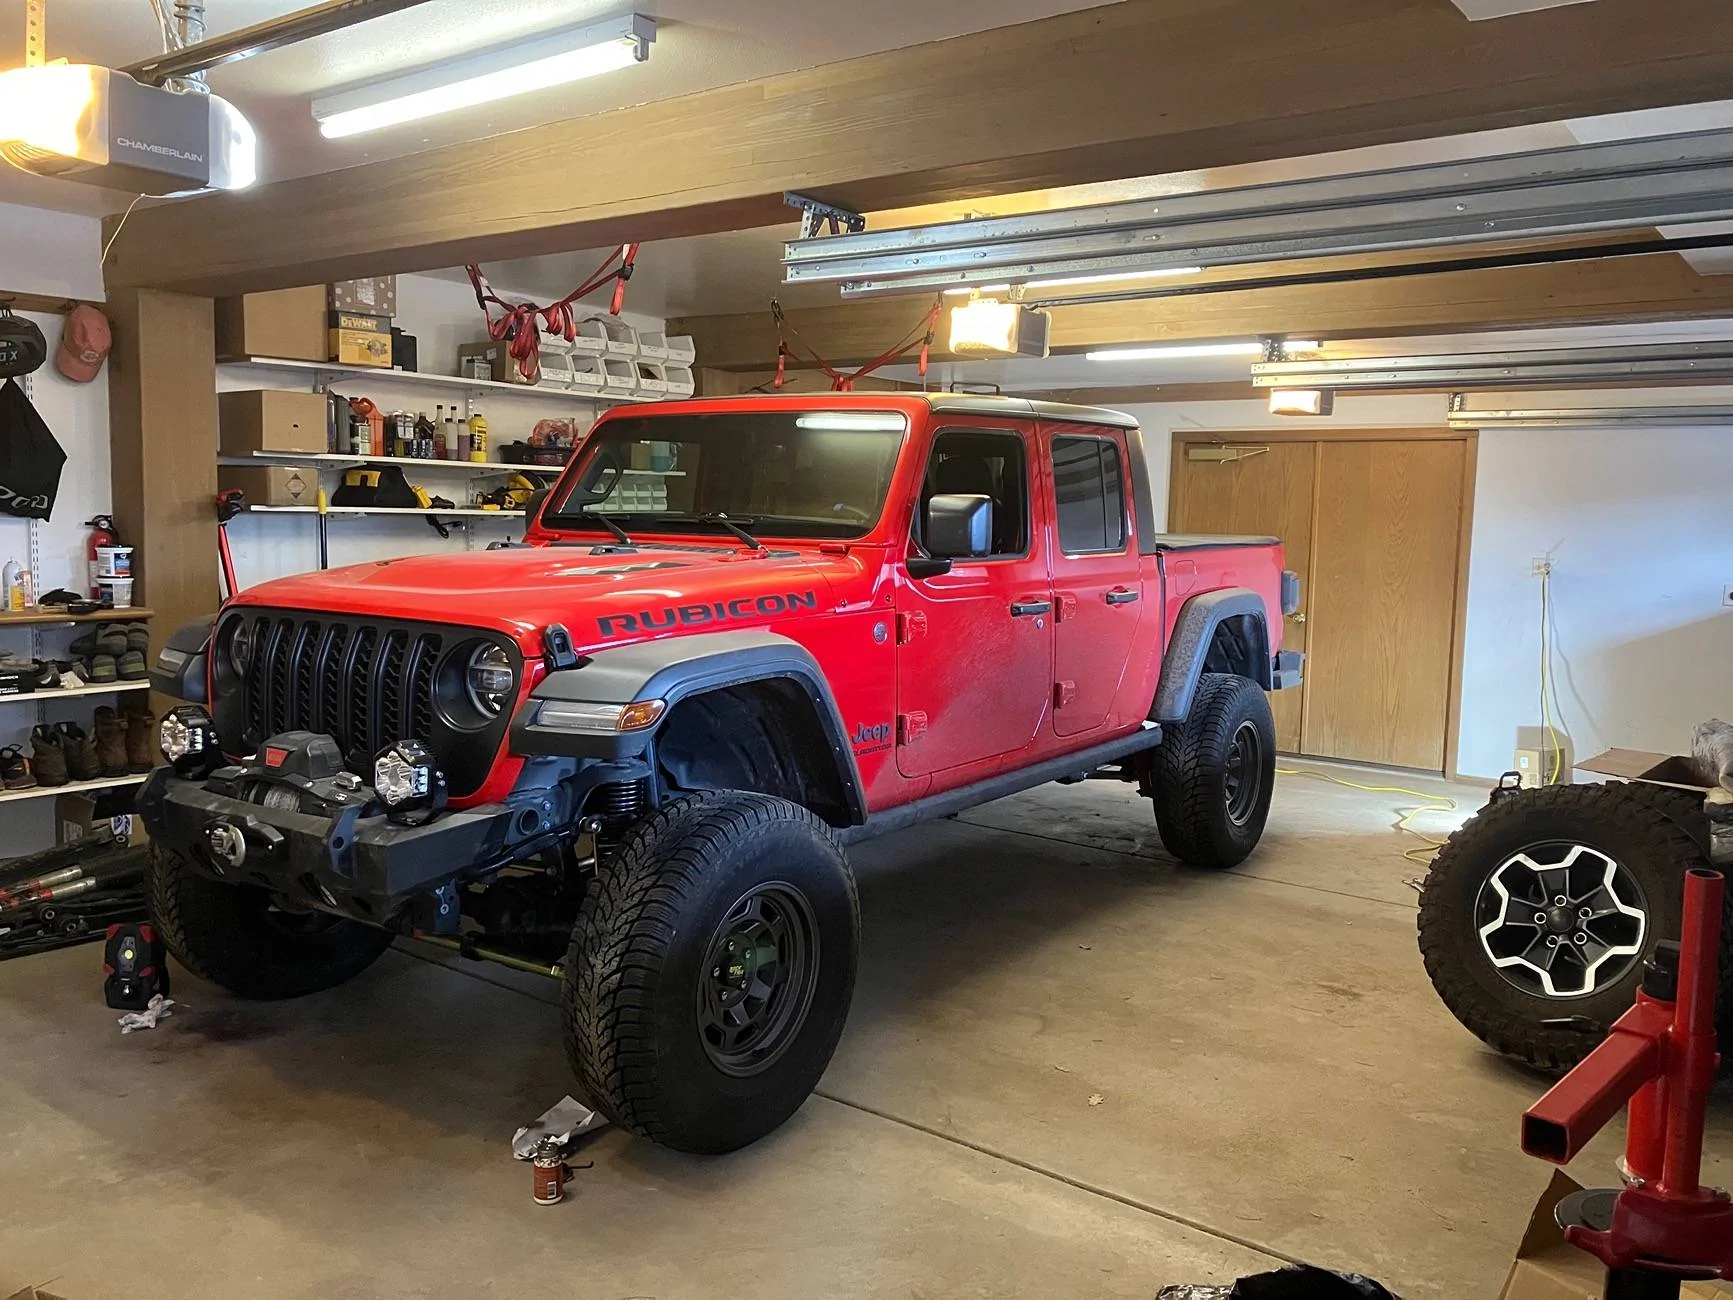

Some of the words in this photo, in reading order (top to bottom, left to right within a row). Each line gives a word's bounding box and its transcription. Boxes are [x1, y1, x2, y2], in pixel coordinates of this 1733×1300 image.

[117, 137, 203, 162] CHAMBERLAIN
[597, 591, 816, 637] RUBICON
[852, 722, 889, 744] Jeep
